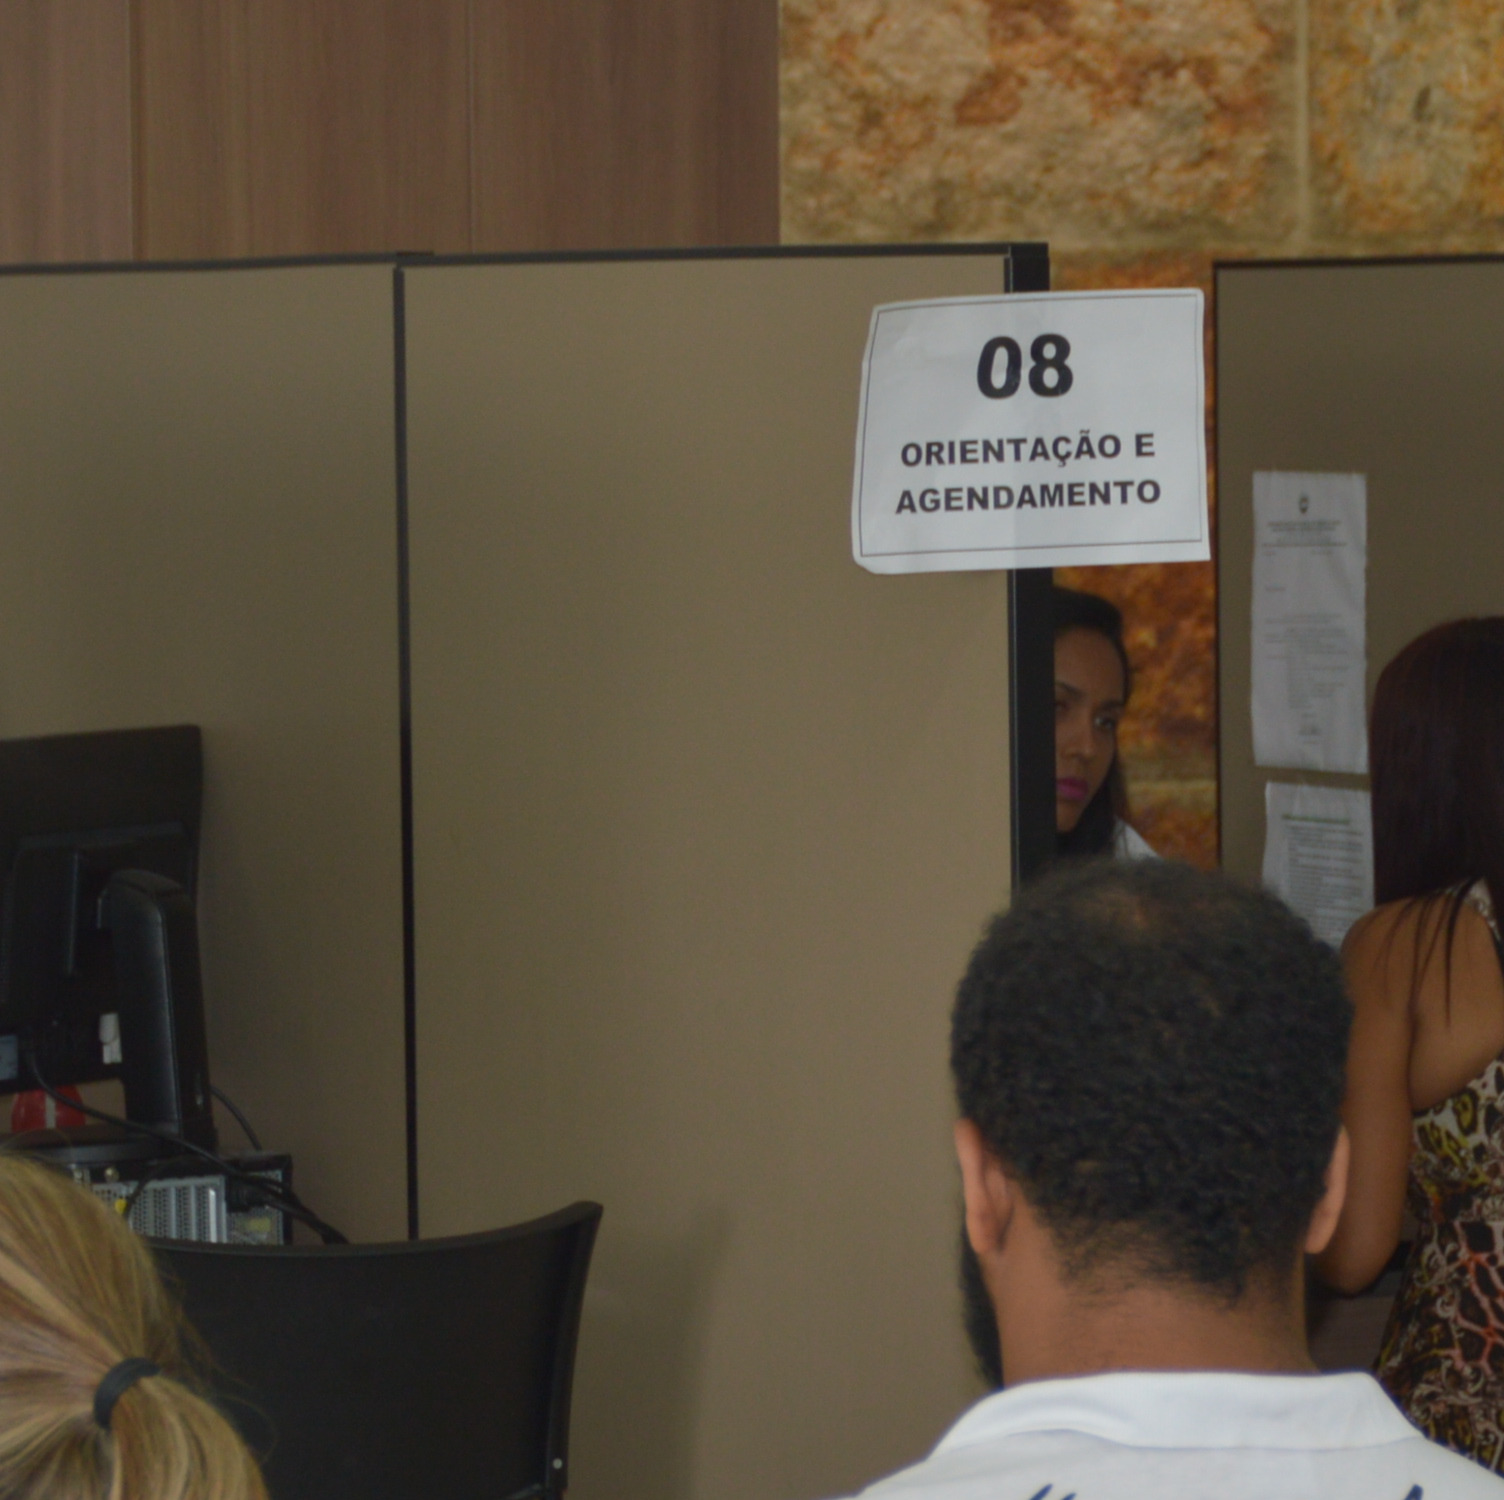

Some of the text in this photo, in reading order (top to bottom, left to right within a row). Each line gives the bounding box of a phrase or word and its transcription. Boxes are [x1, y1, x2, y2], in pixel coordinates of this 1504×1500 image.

[976, 333, 1074, 400] 08
[900, 429, 1156, 467] ORIENTAÇÃO E
[895, 479, 1161, 515] AGENDAMENTO
